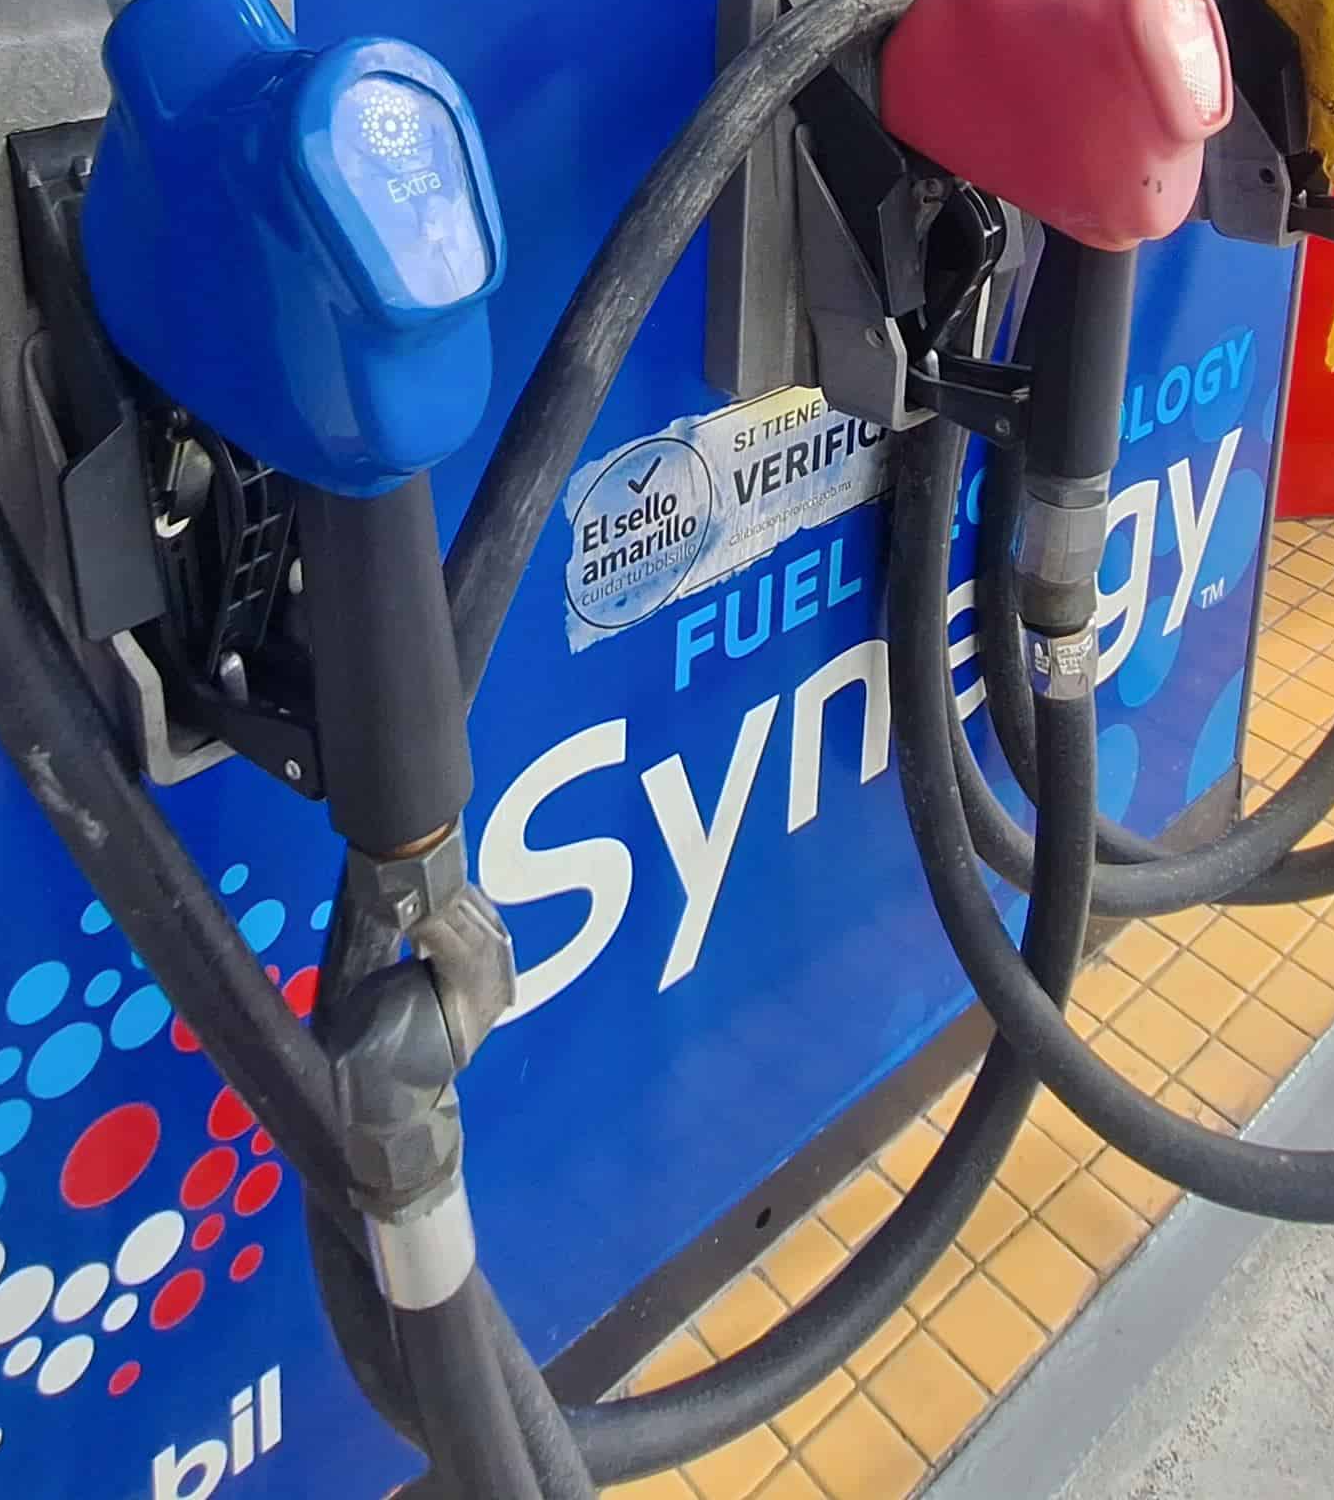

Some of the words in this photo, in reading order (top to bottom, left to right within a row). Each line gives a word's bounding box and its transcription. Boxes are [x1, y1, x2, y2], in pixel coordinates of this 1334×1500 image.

[387, 171, 442, 204] Extra
[734, 426, 756, 453] SI
[762, 399, 822, 440] TIENE
[582, 514, 697, 585] amarillo
[583, 514, 609, 553] El
[614, 492, 677, 539] sello
[582, 577, 624, 606] cuida
[627, 569, 643, 585] tu
[643, 542, 697, 577] bolsillo
[675, 537, 863, 692] FUEL
[478, 427, 1243, 1030] Syngy
